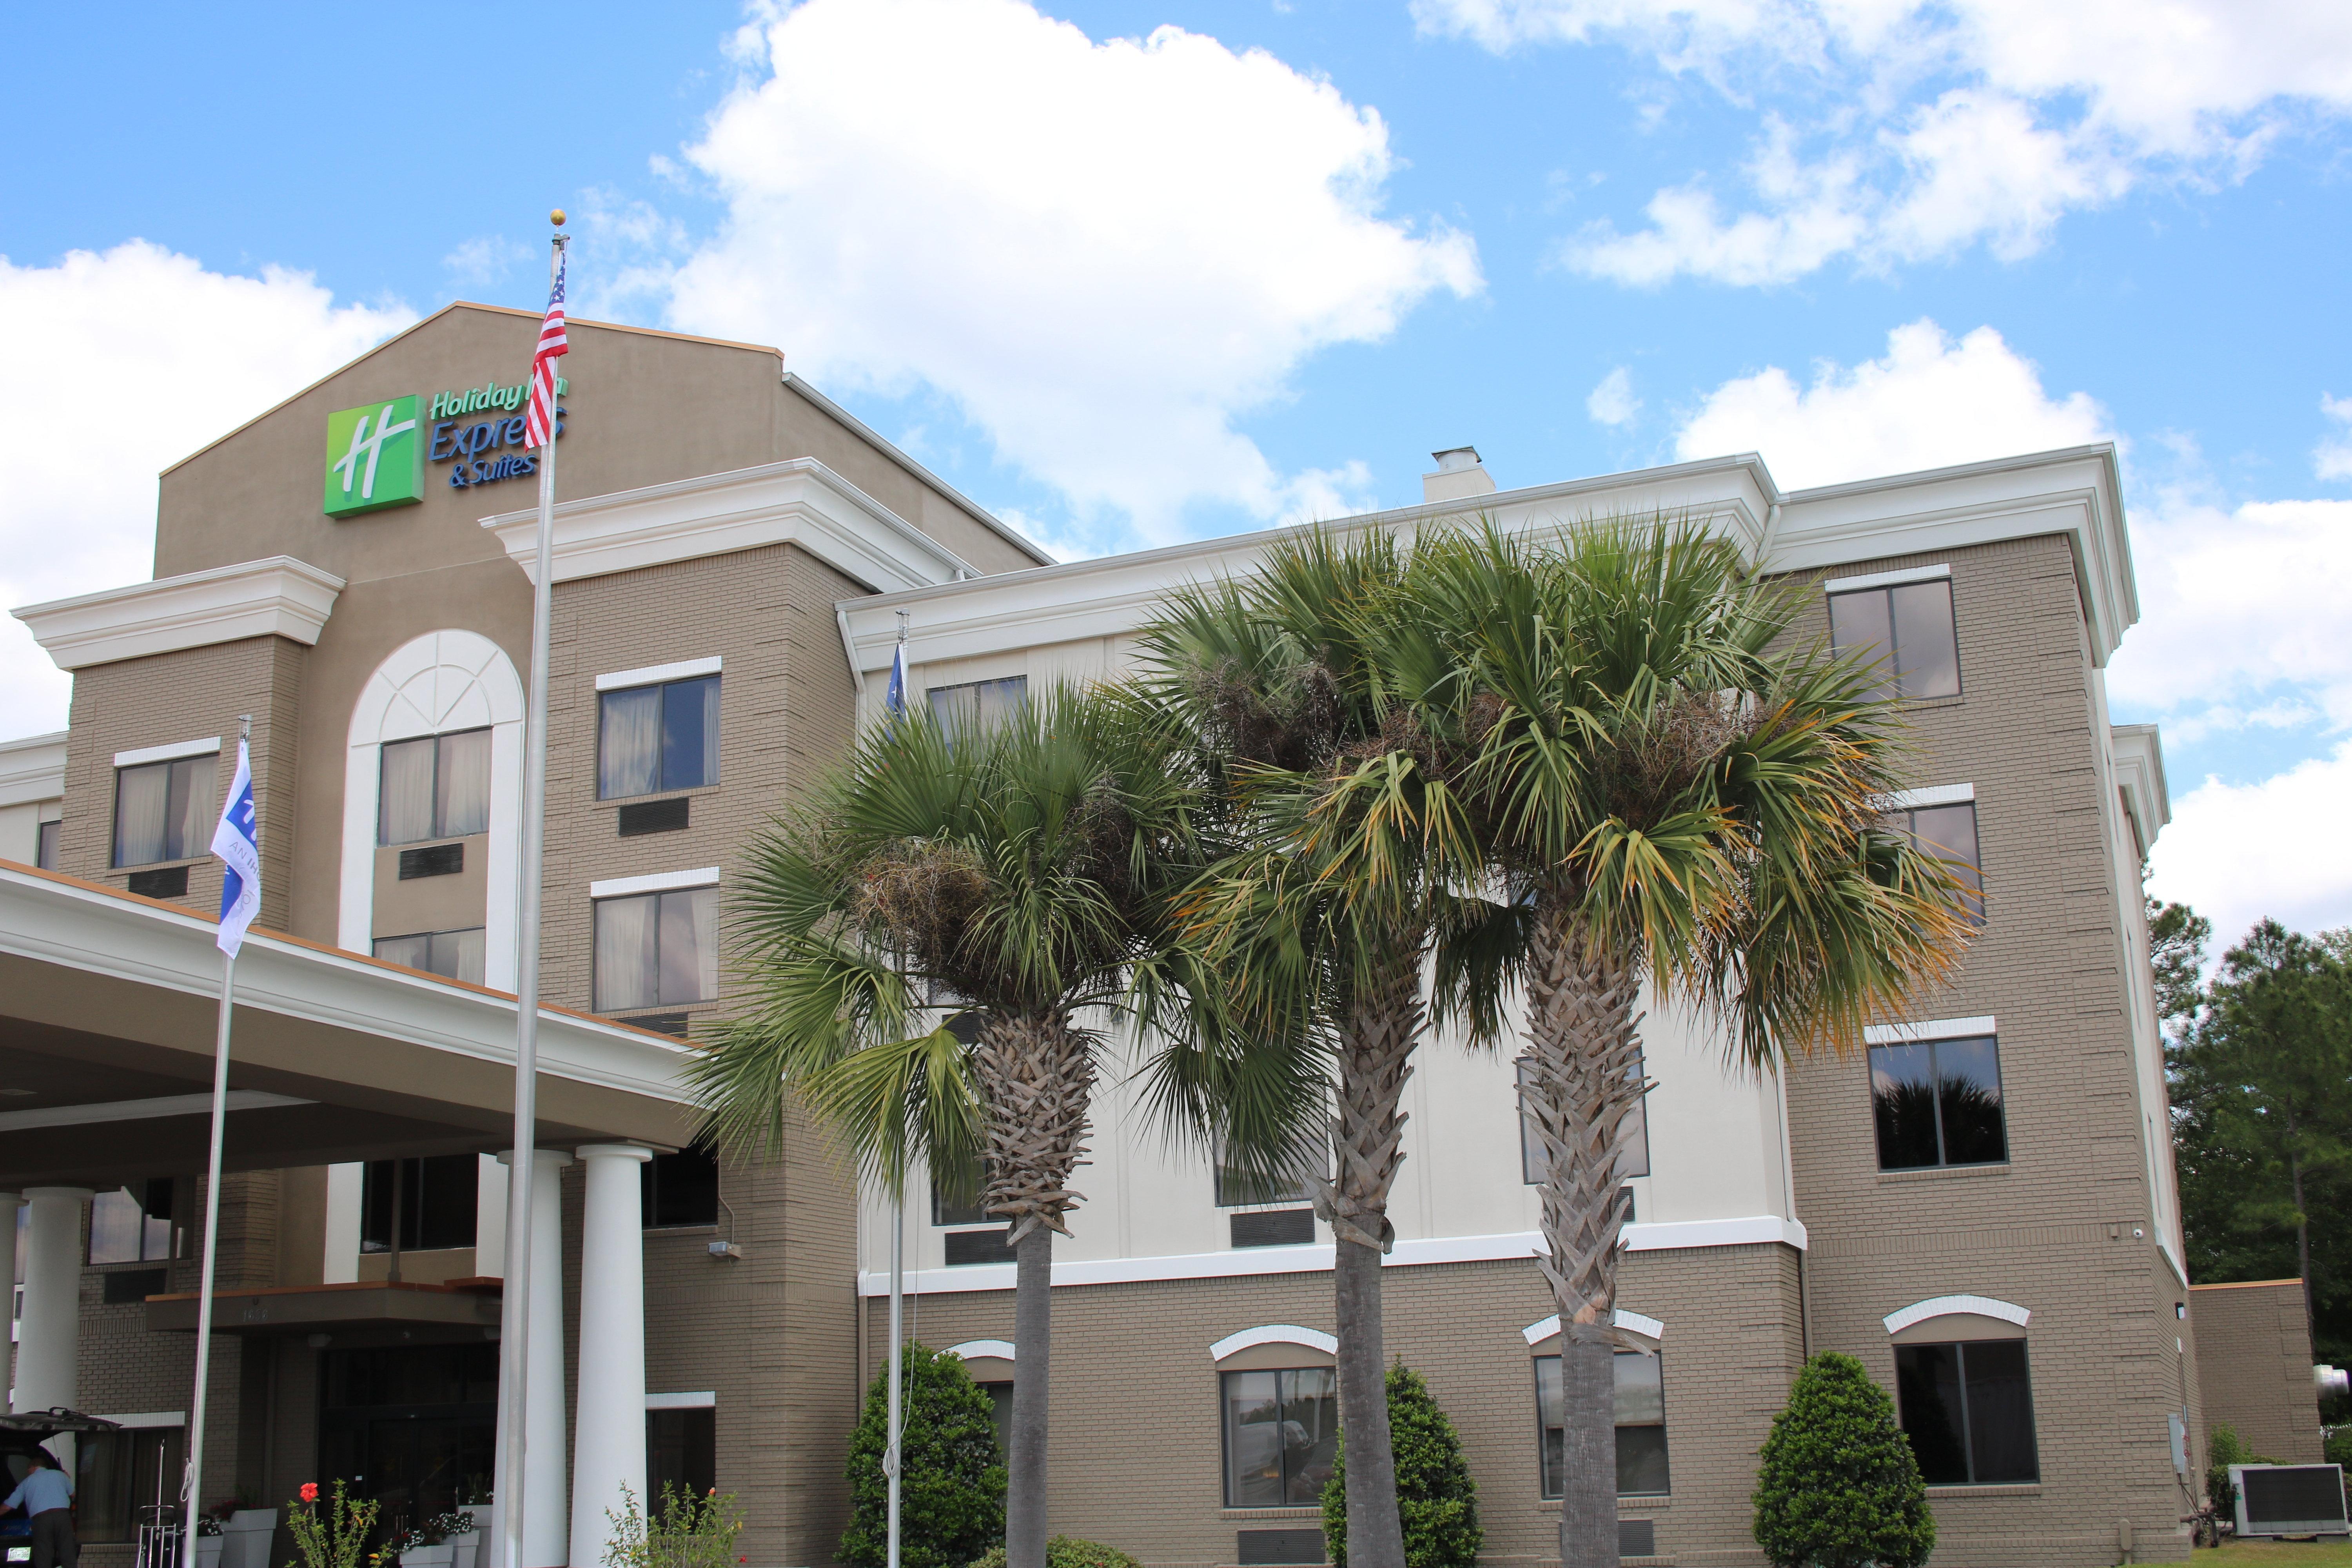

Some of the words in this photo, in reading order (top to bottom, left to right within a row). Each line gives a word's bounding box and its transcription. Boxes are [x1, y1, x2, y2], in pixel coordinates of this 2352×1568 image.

[429, 381, 524, 420] Holiday
[525, 374, 566, 400] In
[449, 463, 468, 487] &
[469, 454, 537, 484] Suites
[229, 841, 247, 859] AN
